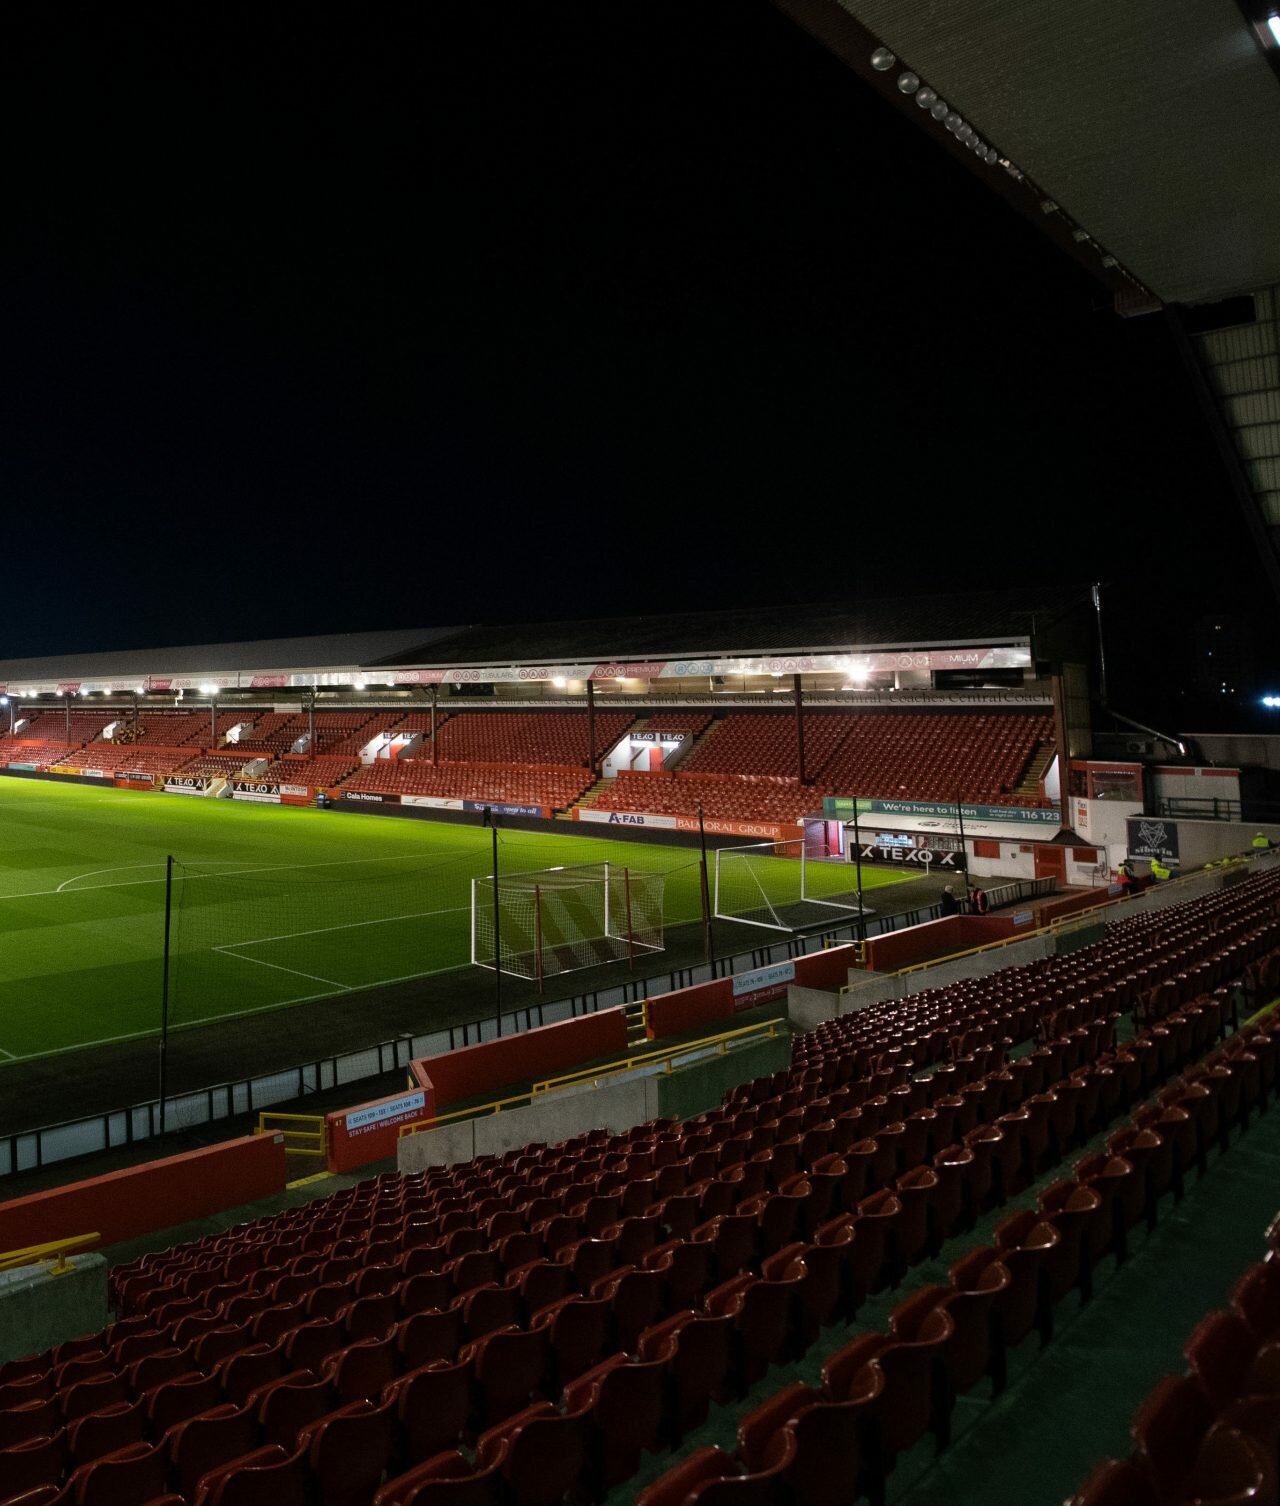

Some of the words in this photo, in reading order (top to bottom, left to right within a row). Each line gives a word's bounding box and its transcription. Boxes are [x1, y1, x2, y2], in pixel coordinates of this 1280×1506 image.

[519, 668, 549, 680] RAM
[595, 666, 626, 677] RAM
[627, 665, 660, 674] PREMIUM
[889, 692, 945, 704] Coaches
[947, 691, 1004, 704] Central
[662, 733, 685, 741] TEXO
[174, 777, 194, 787] TEXO
[244, 783, 268, 794] TEXO
[361, 793, 383, 803] Homes
[883, 803, 911, 812] We're
[913, 804, 935, 813] here
[937, 806, 948, 814] to
[949, 806, 977, 816] listen
[1020, 810, 1038, 820] 116
[1040, 811, 1060, 821] 123
[738, 824, 779, 836] GROUP
[880, 846, 933, 863] TEXO
[349, 1127, 362, 1138] STAY
[363, 1124, 377, 1133] SAFE
[379, 1116, 404, 1127] WELCOME
[404, 1110, 418, 1119] BACK
[352, 1114, 367, 1123] SEATS
